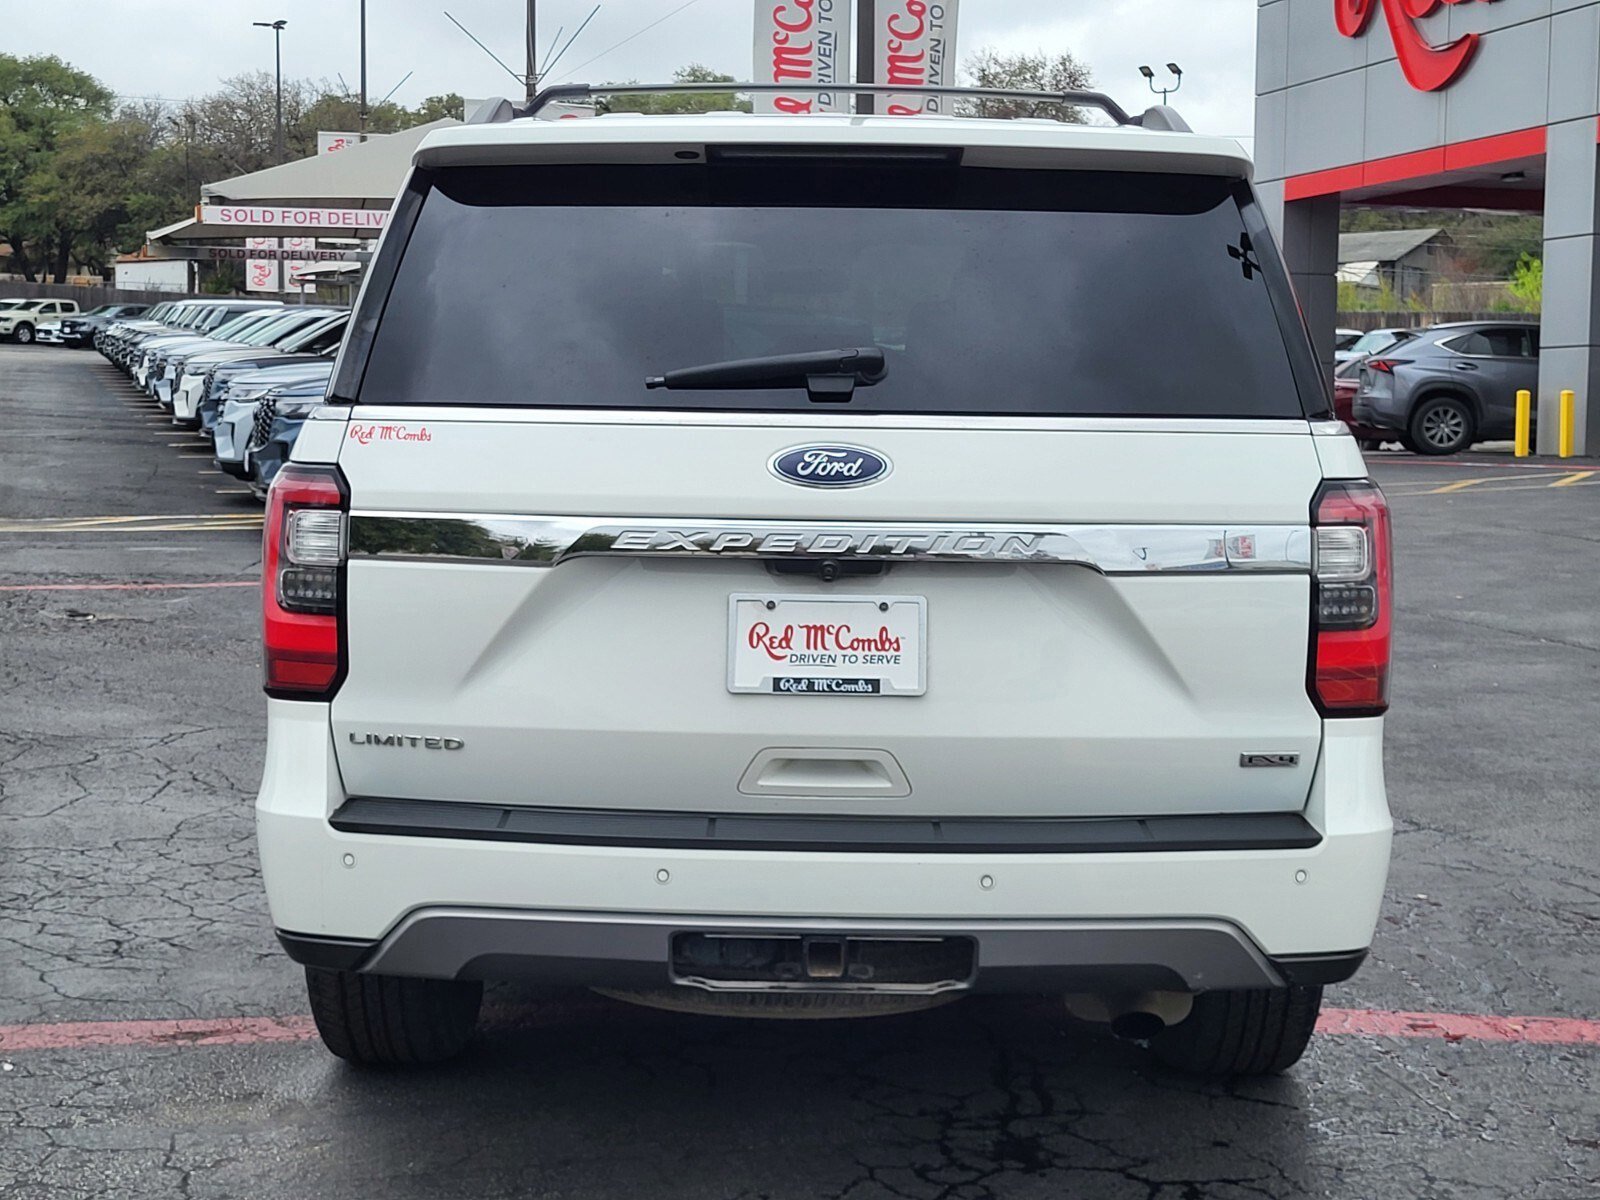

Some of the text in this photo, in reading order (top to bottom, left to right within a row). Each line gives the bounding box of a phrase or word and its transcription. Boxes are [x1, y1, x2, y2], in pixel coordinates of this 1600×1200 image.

[927, 5, 944, 112] DIVEN TO
[220, 208, 389, 226] SOLD FOR DELIV
[209, 248, 346, 261] SOLD FOR DELIVERY
[350, 424, 431, 444] Red McCombs
[796, 450, 864, 478] Ford
[610, 529, 1045, 556] EXPEDITION
[748, 621, 901, 660] Red McCombs
[789, 653, 901, 665] DRIVEN TO SERVE
[779, 678, 873, 692] Red McCombs
[349, 732, 465, 750] LIMITED
